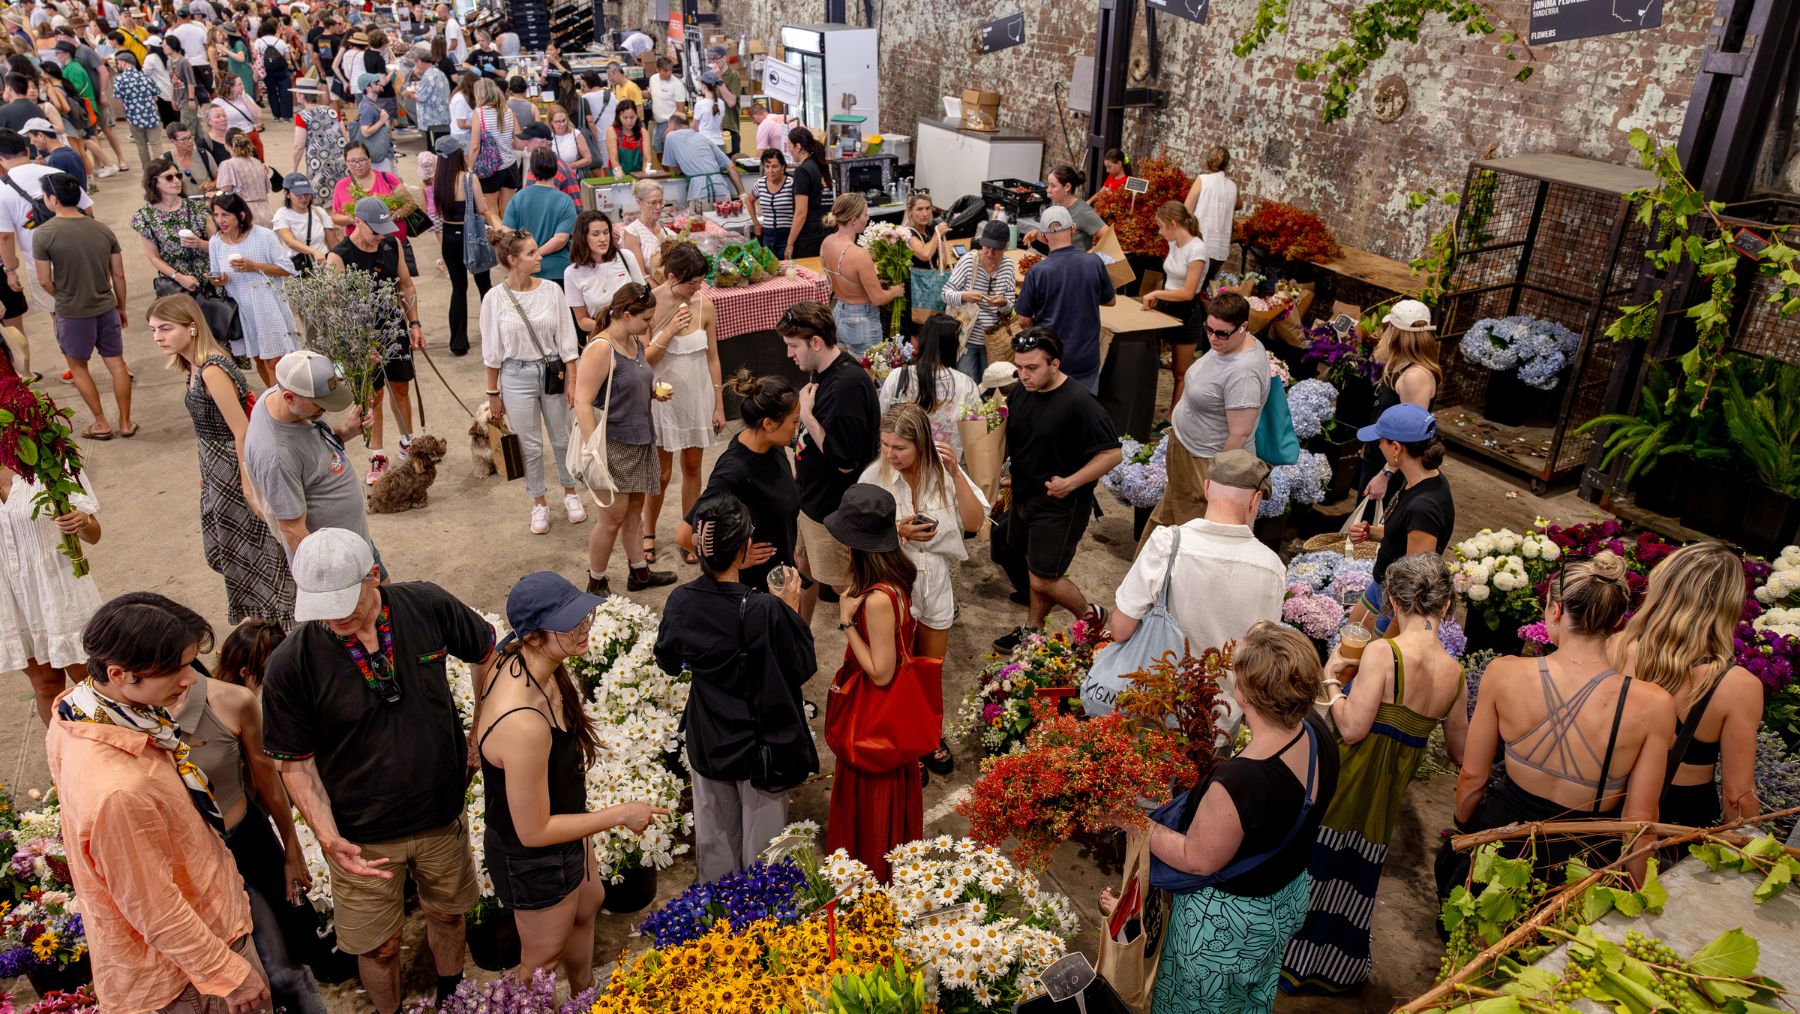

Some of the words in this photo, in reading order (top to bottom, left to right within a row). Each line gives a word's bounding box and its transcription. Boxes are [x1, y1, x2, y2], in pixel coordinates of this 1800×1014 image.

[1533, 0, 1557, 10] JONIMA
[1532, 7, 1559, 17] YANDERRA
[1531, 29, 1556, 39] FLOWERS
